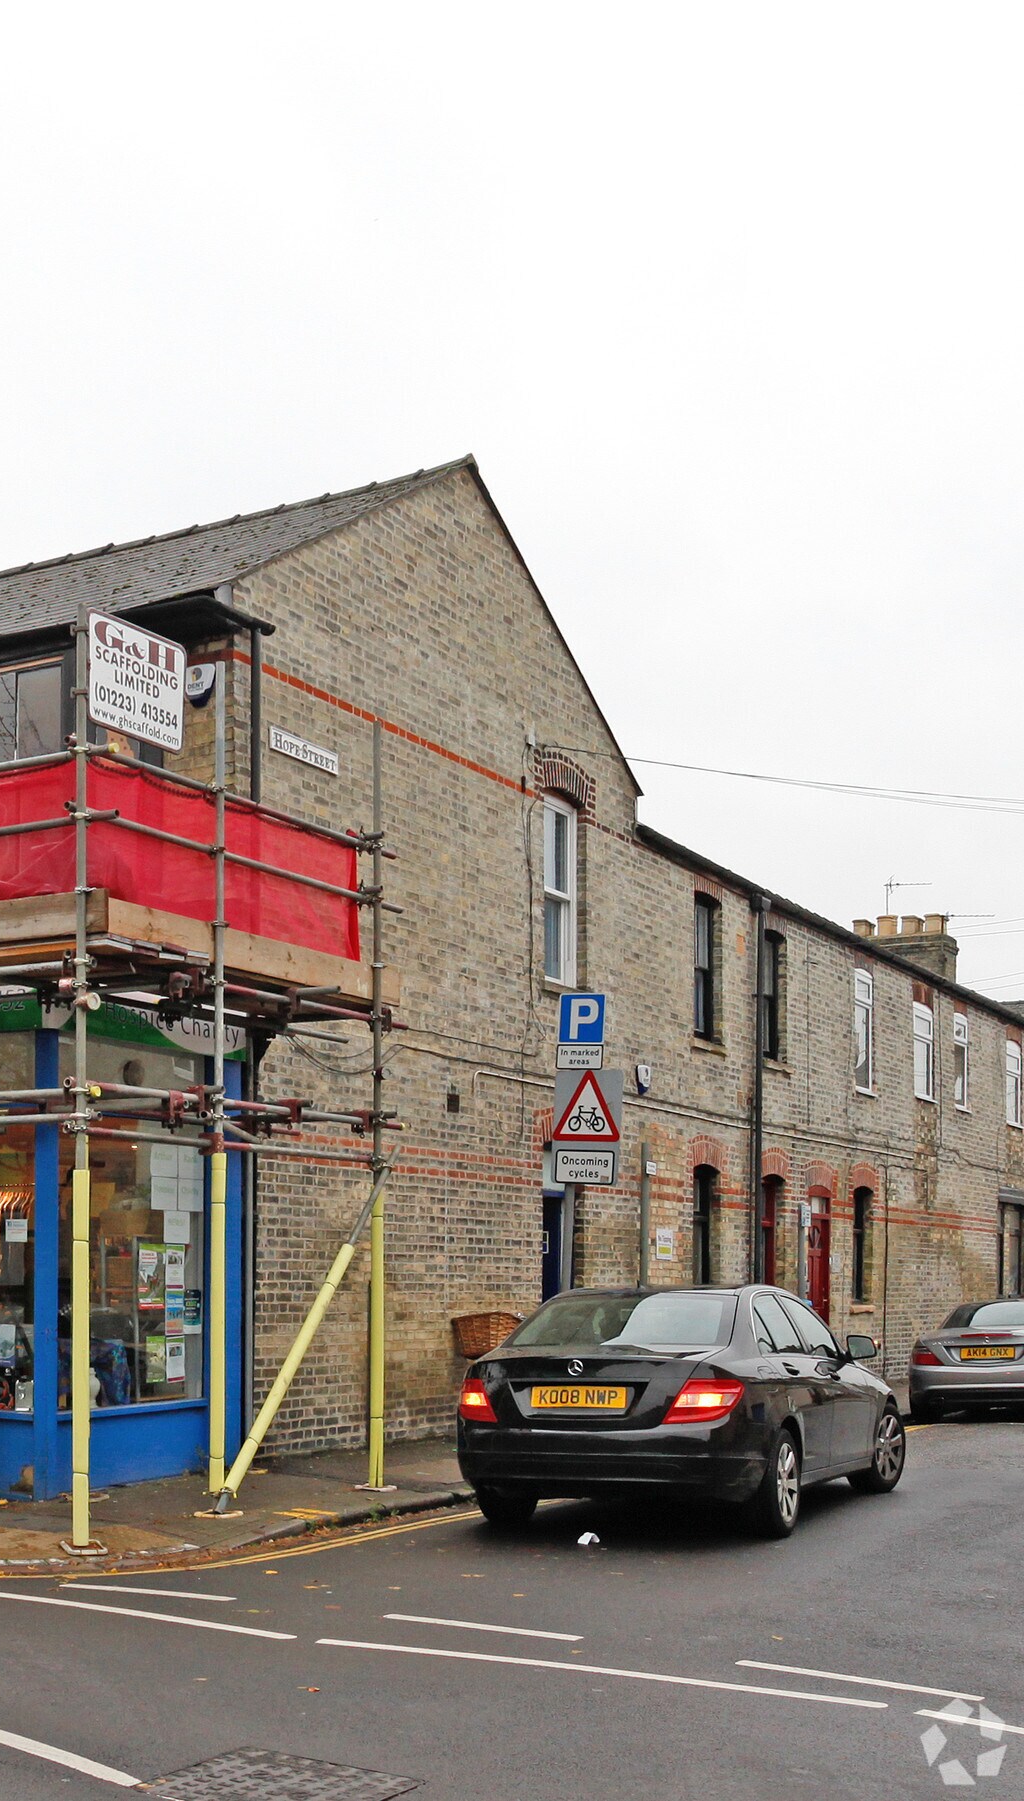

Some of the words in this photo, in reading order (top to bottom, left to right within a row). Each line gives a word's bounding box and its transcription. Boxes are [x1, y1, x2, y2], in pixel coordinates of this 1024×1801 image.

[94, 621, 179, 675] G&H
[95, 645, 179, 690] SCAFFOLDING
[114, 669, 160, 699] LIMITED
[94, 682, 136, 715] (01223)
[140, 702, 178, 730] 413554
[93, 707, 180, 747] www.ghscaffold.com
[273, 731, 300, 757] HOPE
[301, 743, 336, 771] STREET
[181, 1017, 239, 1049] Charty
[569, 999, 599, 1040] P
[560, 1049, 569, 1057] In
[570, 1049, 600, 1057] marked
[561, 1155, 609, 1168] Oncoming
[568, 1169, 599, 1179] cycles
[966, 1349, 987, 1358] AK14
[989, 1348, 1009, 1357] GNX
[538, 1389, 580, 1405] KO08
[584, 1389, 618, 1405] NWP
